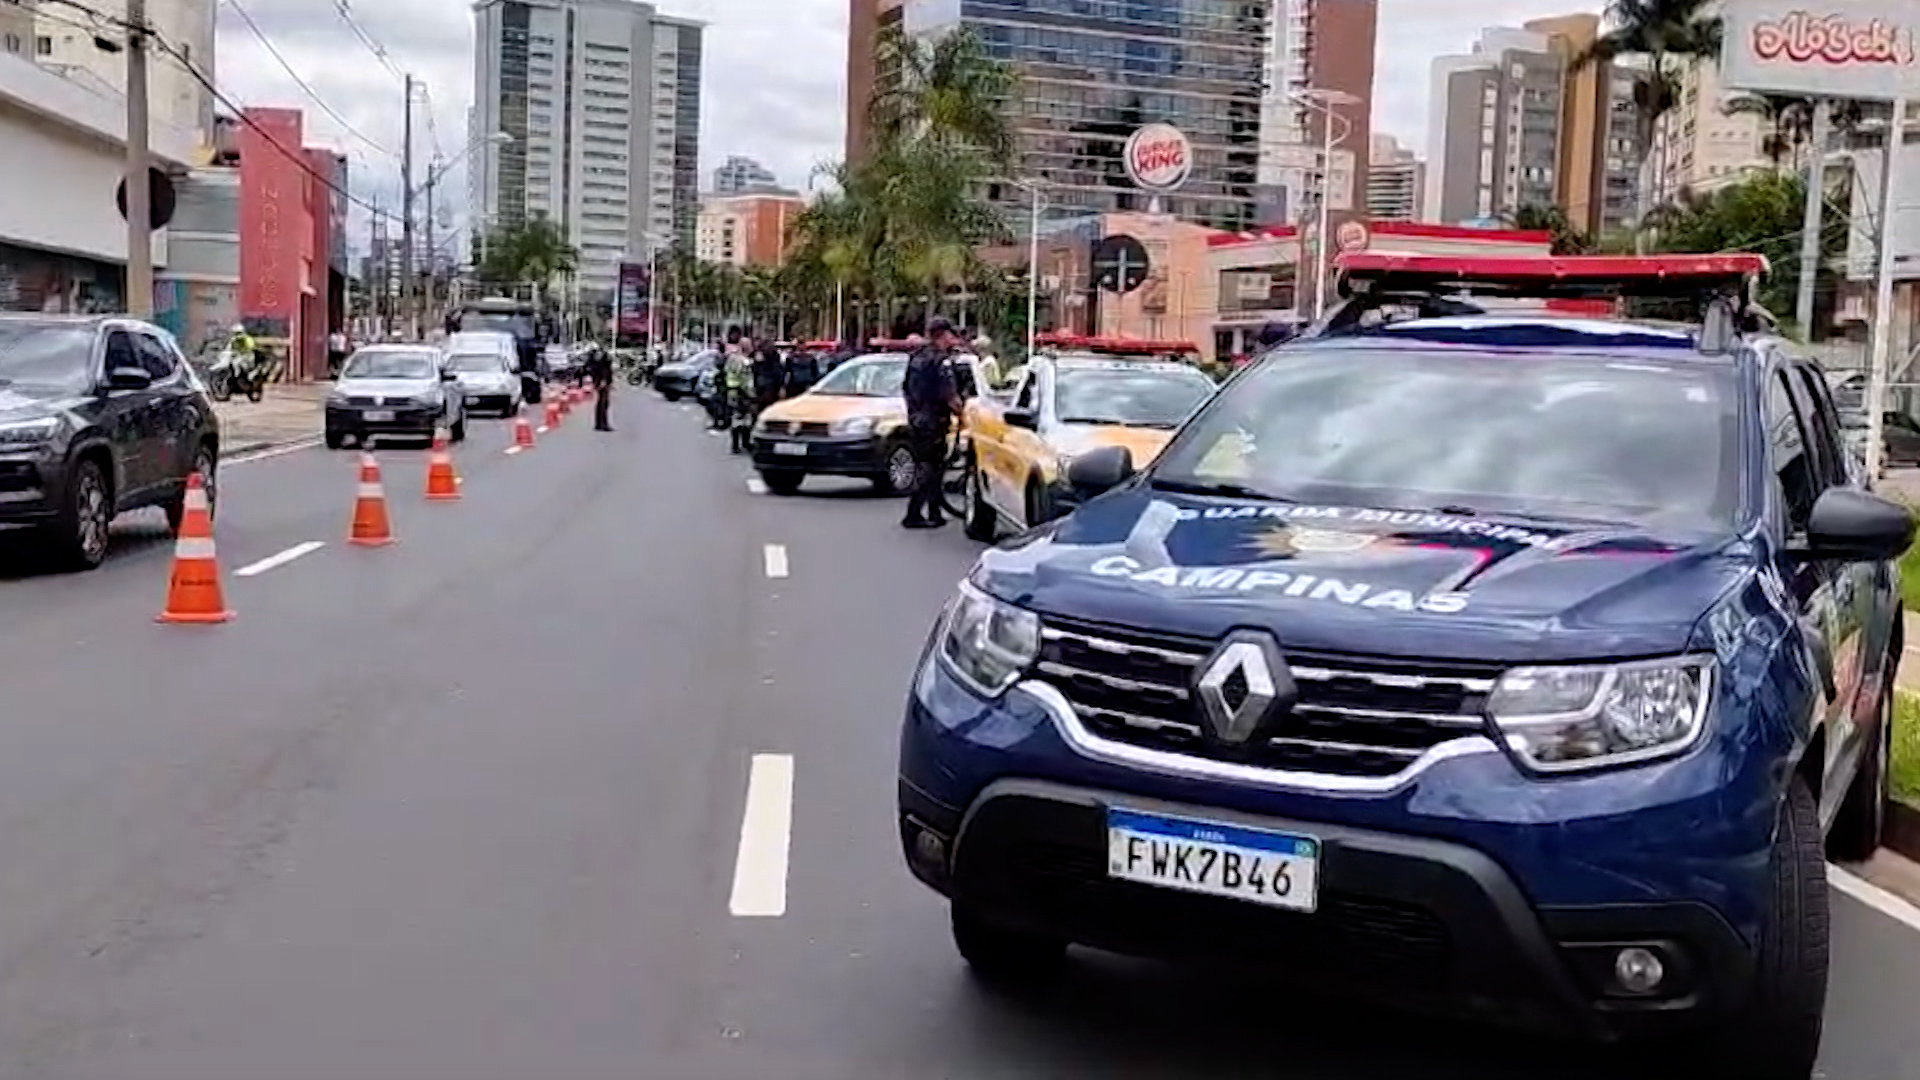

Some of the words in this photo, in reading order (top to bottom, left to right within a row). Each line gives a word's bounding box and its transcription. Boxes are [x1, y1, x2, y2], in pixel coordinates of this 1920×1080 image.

[1138, 151, 1184, 172] KING
[1091, 555, 1471, 612] CAMPINAS
[1127, 837, 1292, 896] FWK7B46
